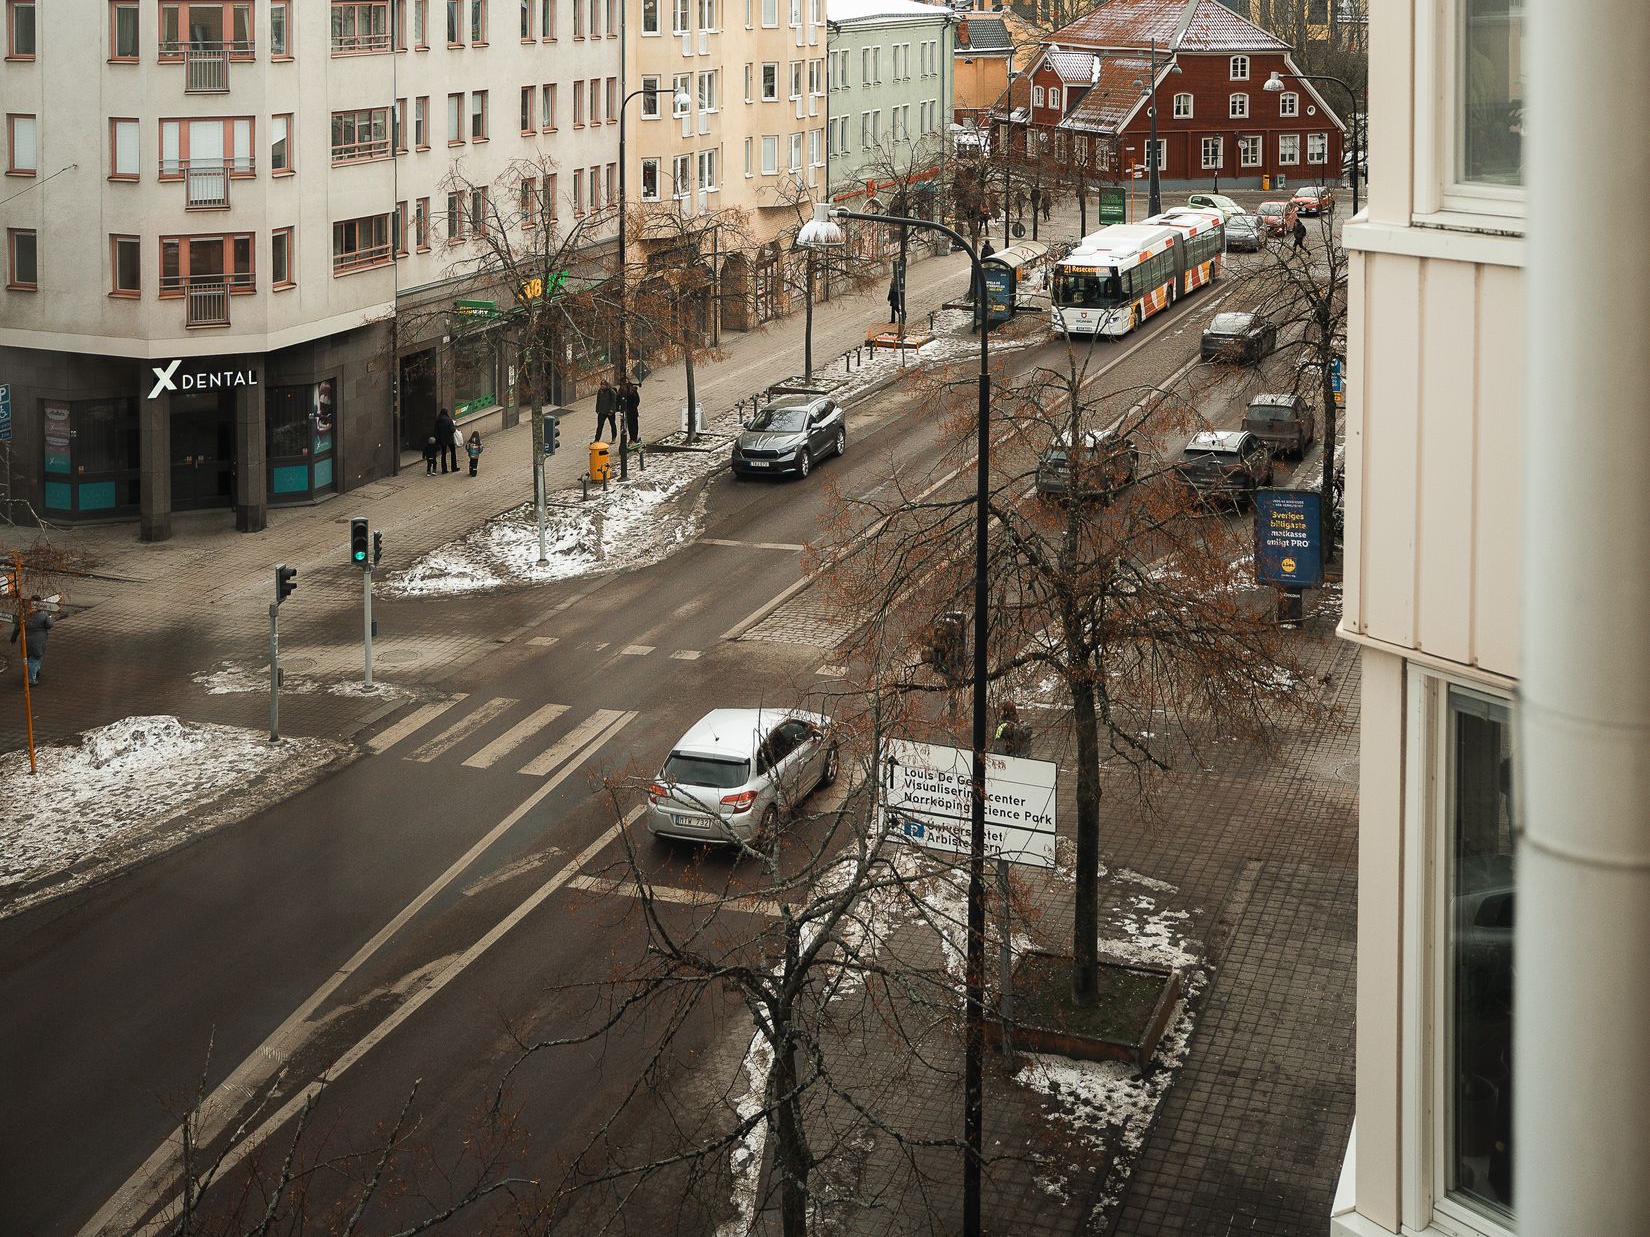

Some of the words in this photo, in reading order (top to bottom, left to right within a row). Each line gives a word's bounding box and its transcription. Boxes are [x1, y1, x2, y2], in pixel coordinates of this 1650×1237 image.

[182, 370, 258, 390] DENTAL
[1271, 511, 1305, 521] Sveriges
[904, 766, 934, 781] Louis
[938, 772, 953, 784] De
[957, 775, 975, 788] Ge
[904, 791, 971, 814] Norrköping
[979, 804, 1020, 820] cience
[1024, 810, 1052, 825] Park
